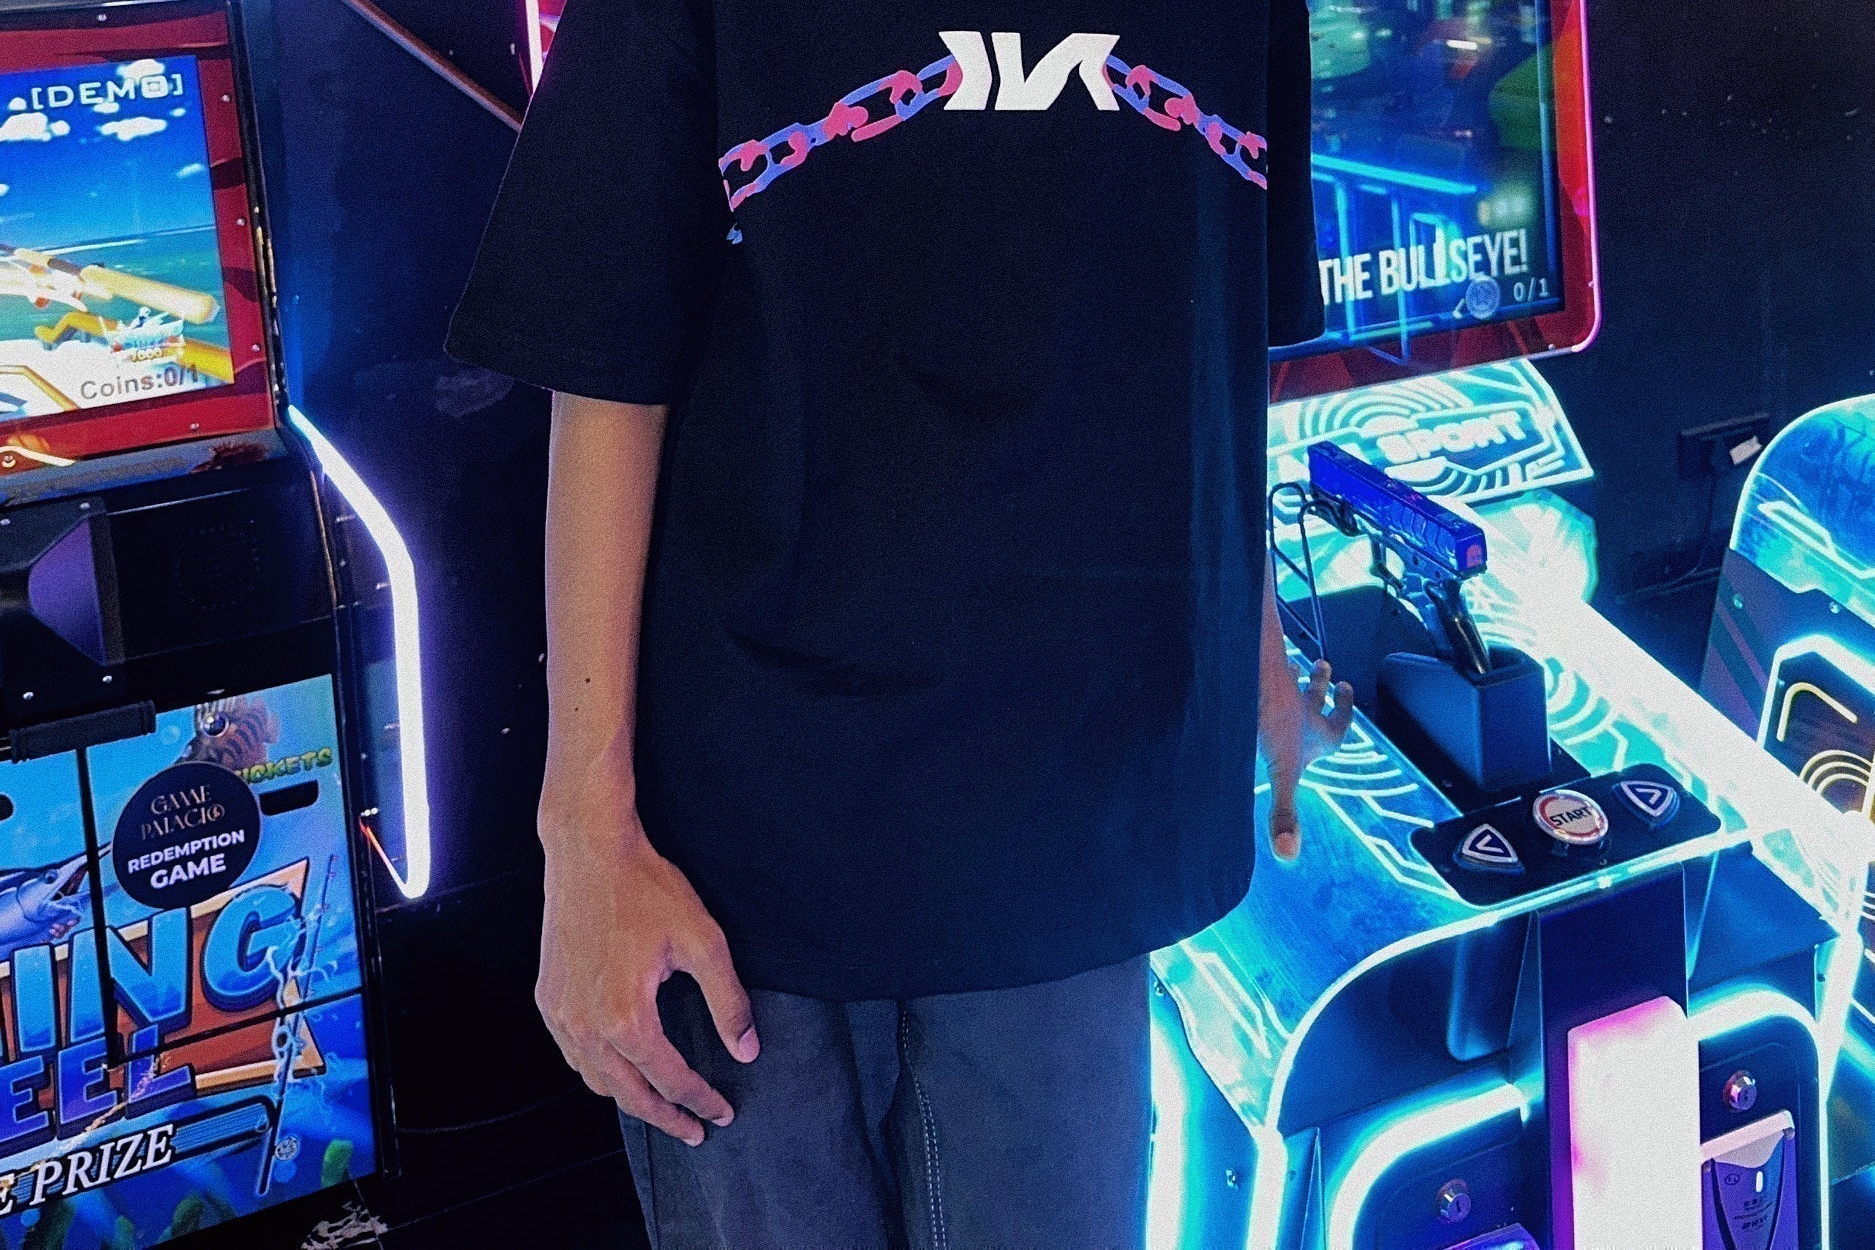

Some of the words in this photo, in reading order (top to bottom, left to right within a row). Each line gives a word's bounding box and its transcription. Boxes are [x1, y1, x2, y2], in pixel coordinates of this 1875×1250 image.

[1318, 252, 1374, 306] THE
[1379, 228, 1528, 296] BULLSEYE!
[1513, 277, 1549, 302] 0/1
[80, 363, 199, 400] Coins:0/1
[235, 747, 333, 785] ICKETS
[1549, 806, 1592, 826] START
[127, 829, 246, 874] REDEMPTION
[150, 853, 227, 890] GAME
[0, 883, 306, 1052] ING
[29, 1123, 174, 1207] PRIZE
